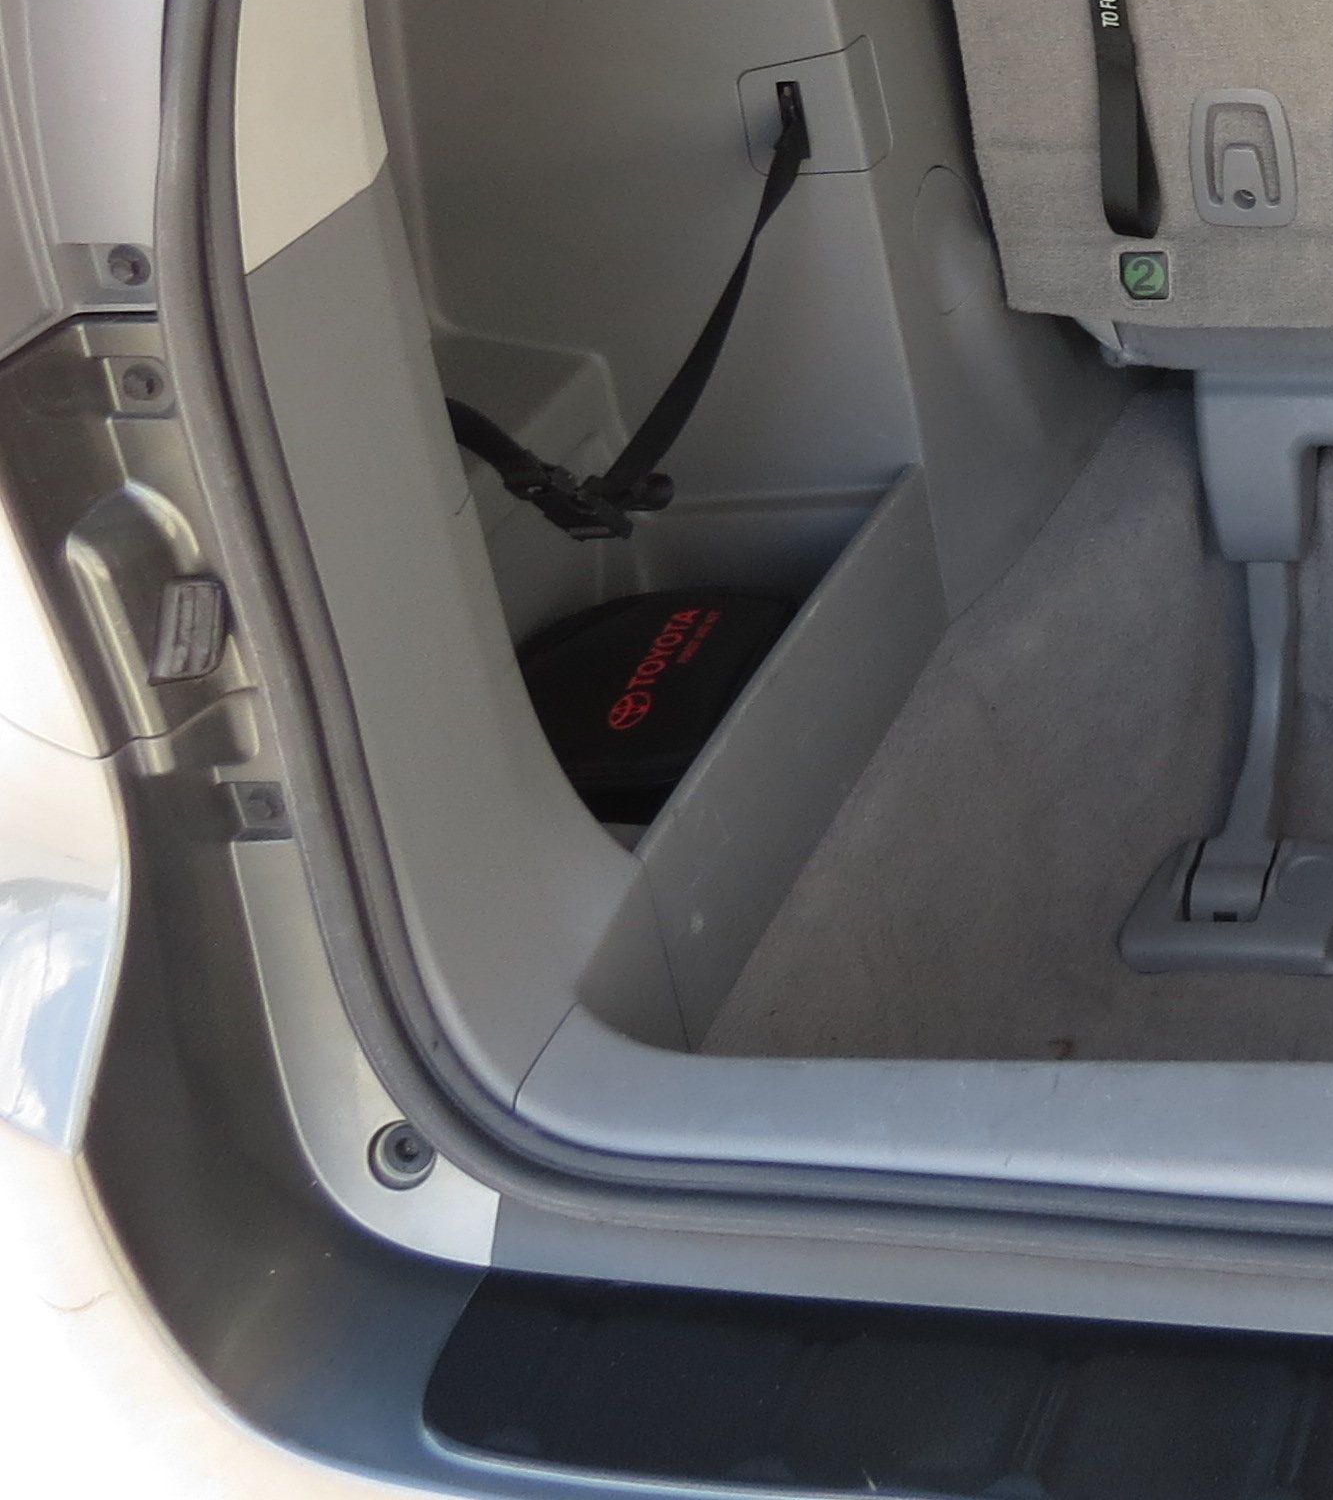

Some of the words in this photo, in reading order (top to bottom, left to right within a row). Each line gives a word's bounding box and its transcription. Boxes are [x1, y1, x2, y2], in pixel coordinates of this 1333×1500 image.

[1102, 12, 1120, 28] TO
[1132, 258, 1156, 291] 2
[627, 609, 701, 689] TOYOTA
